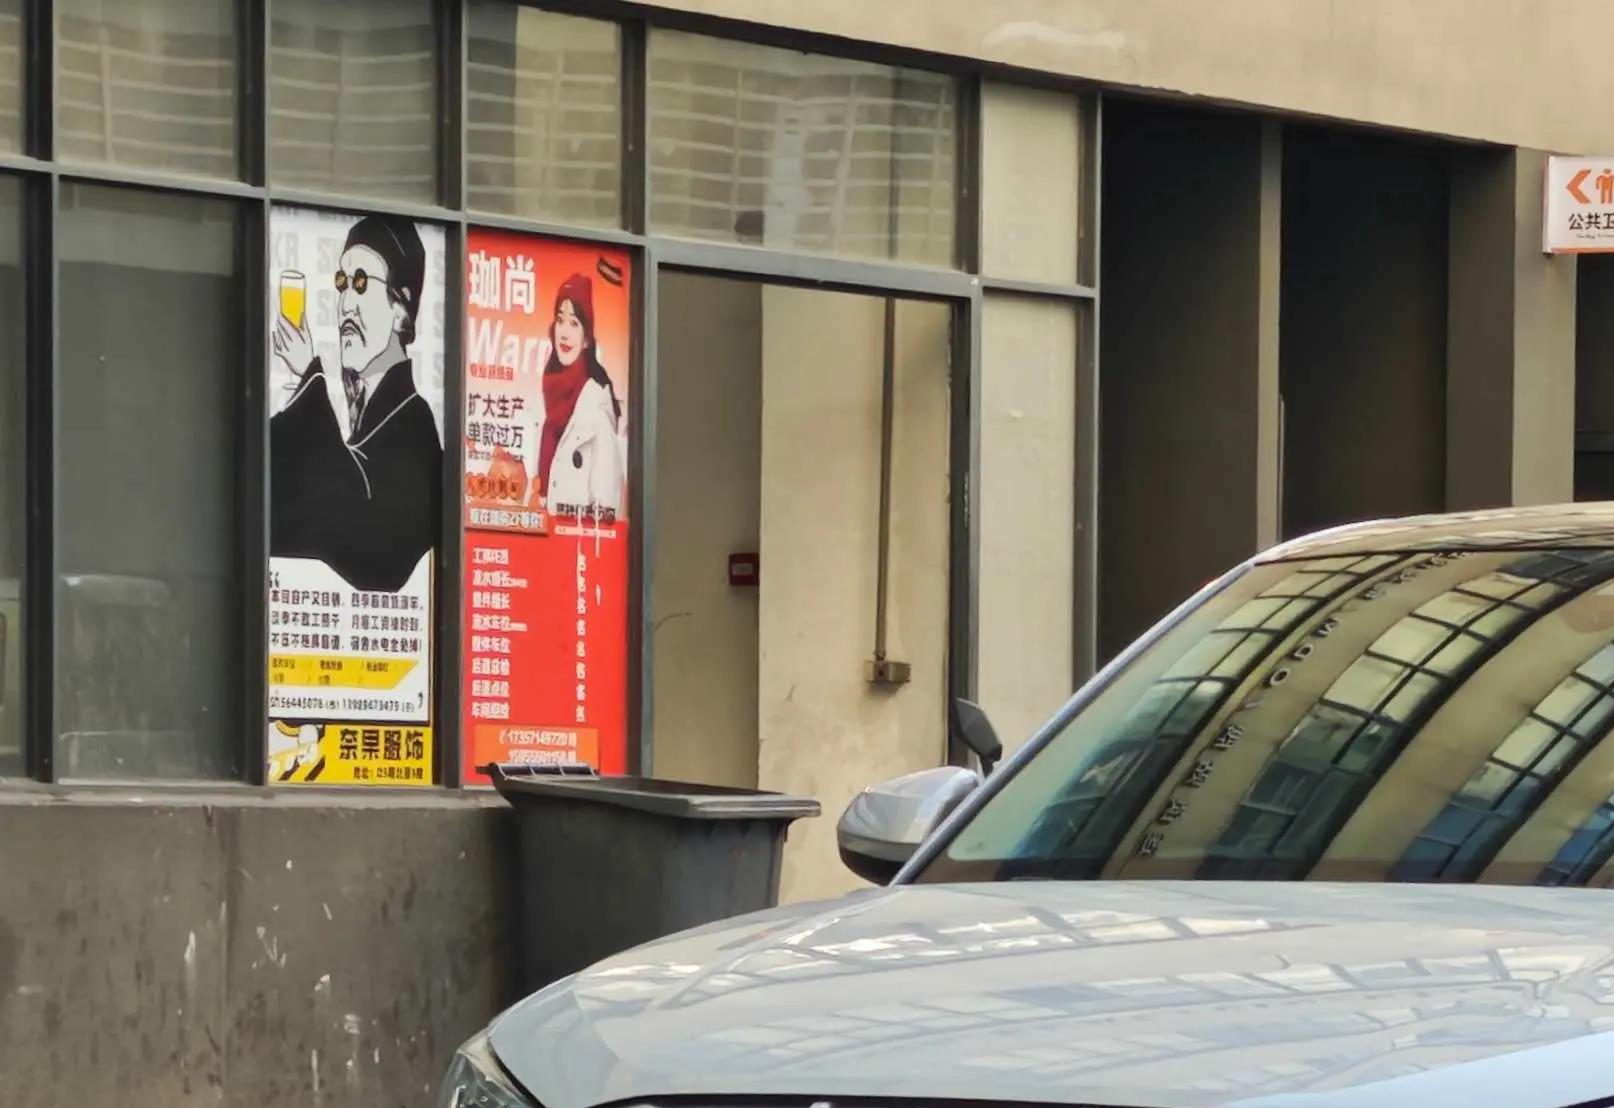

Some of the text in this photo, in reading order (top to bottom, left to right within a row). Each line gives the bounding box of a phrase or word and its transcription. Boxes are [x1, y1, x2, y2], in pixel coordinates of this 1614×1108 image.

[468, 393, 525, 419] 扩大生产
[468, 422, 525, 449] 单款过万
[339, 728, 424, 761] 奈果服饰
